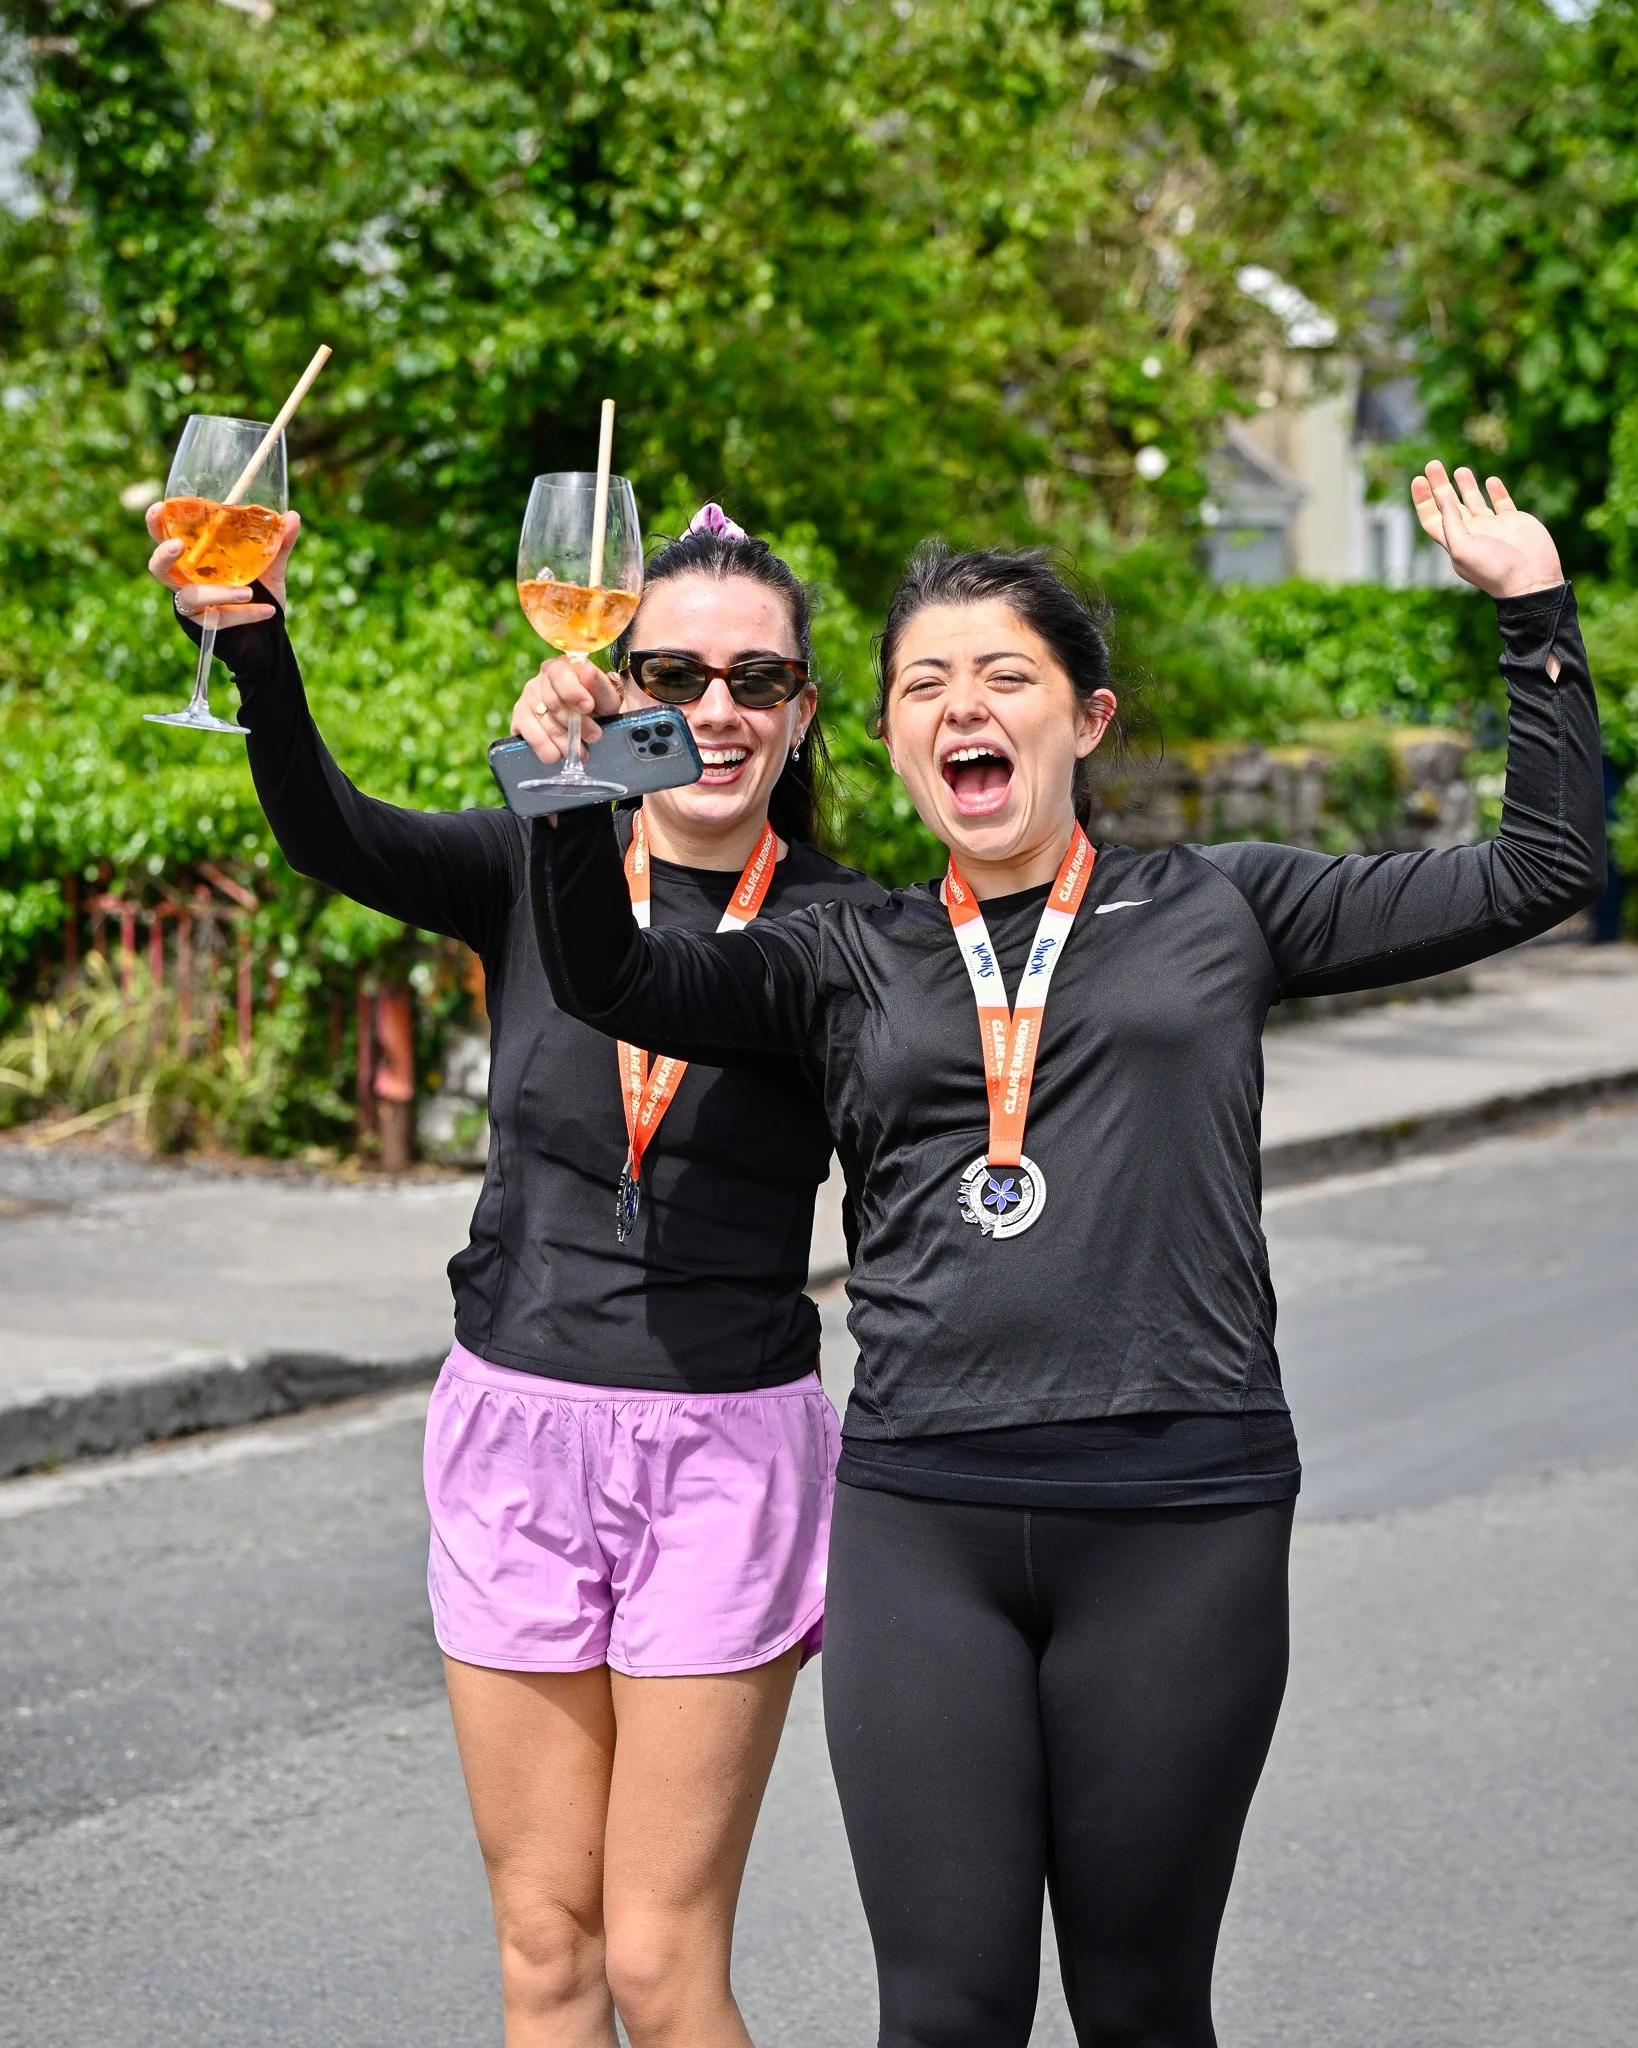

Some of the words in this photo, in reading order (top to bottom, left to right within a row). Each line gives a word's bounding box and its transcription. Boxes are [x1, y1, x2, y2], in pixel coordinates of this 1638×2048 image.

[738, 868, 760, 907] CLARE
[749, 874, 767, 909] MARATHON
[1058, 868, 1079, 903] CLARE
[970, 942, 994, 978] MONKS
[1028, 938, 1057, 976] MONKS
[991, 1019, 1007, 1060] CLARE
[1011, 1018, 1031, 1069] BURREN
[641, 1084, 663, 1126] CLARE
[656, 1057, 675, 1087] BUR
[1004, 1067, 1022, 1115] CLARE
[1017, 1067, 1028, 1114] MARATHON
